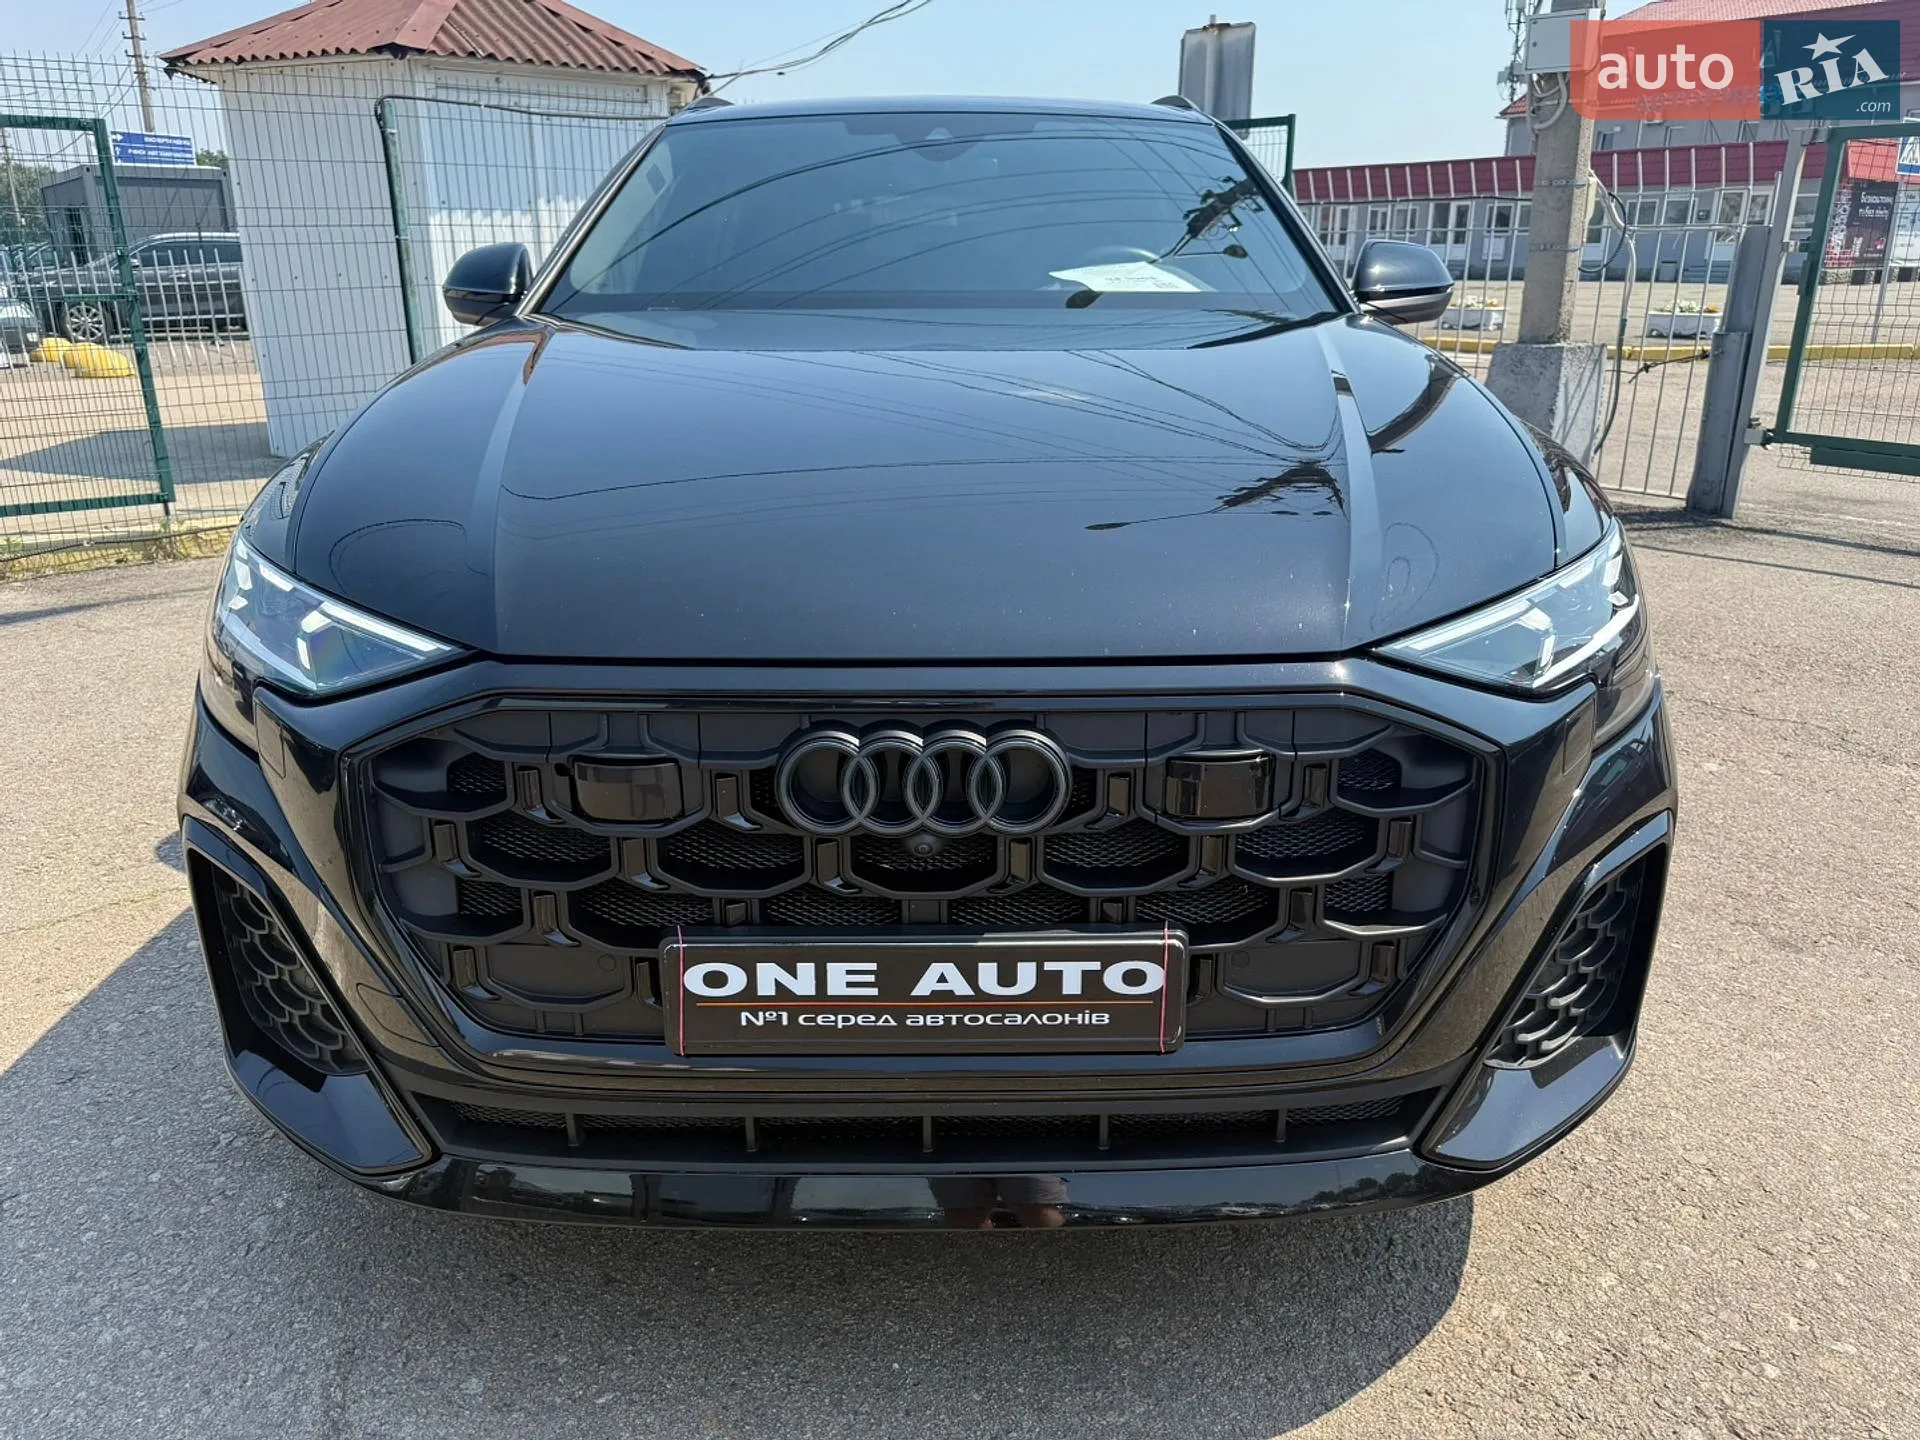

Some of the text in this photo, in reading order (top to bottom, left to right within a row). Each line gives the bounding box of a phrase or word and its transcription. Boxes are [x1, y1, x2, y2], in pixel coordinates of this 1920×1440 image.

[684, 961, 1166, 997] ONE AUTO
[740, 1010, 1110, 1029] №1 серед автосалонів
